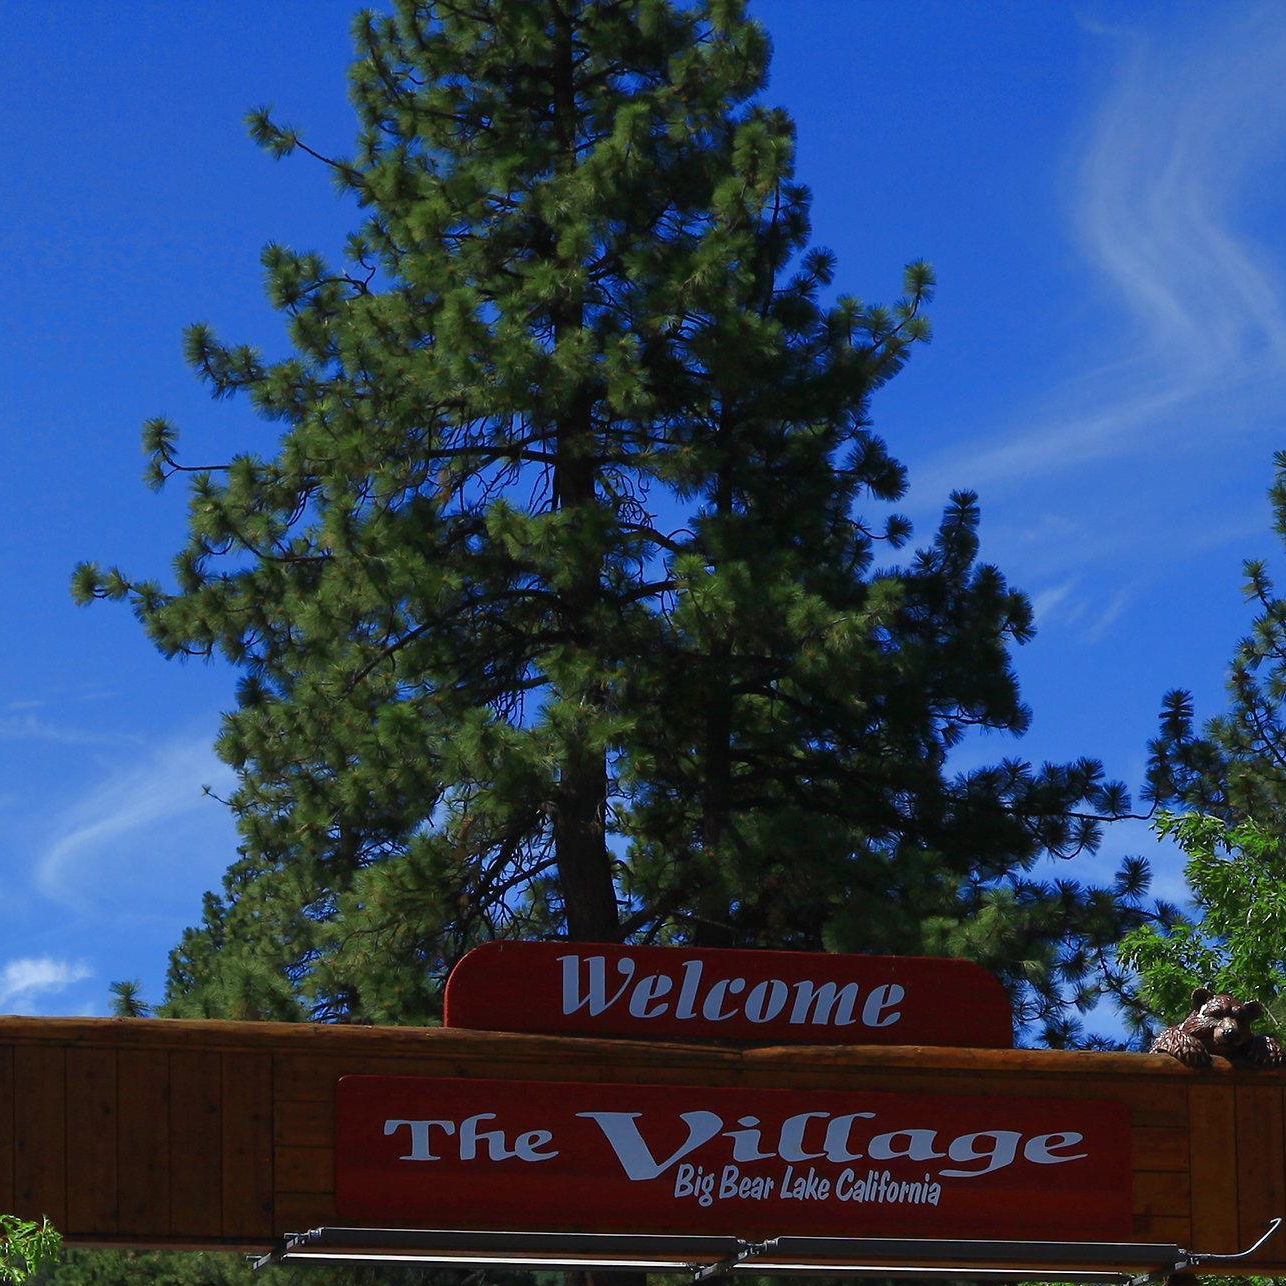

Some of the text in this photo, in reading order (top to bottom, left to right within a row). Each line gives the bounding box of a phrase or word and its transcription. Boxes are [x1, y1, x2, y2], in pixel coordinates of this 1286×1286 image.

[556, 954, 905, 1028] Welcome
[383, 1110, 1088, 1181] The Village
[673, 1163, 942, 1207] Big Bear Lake California
